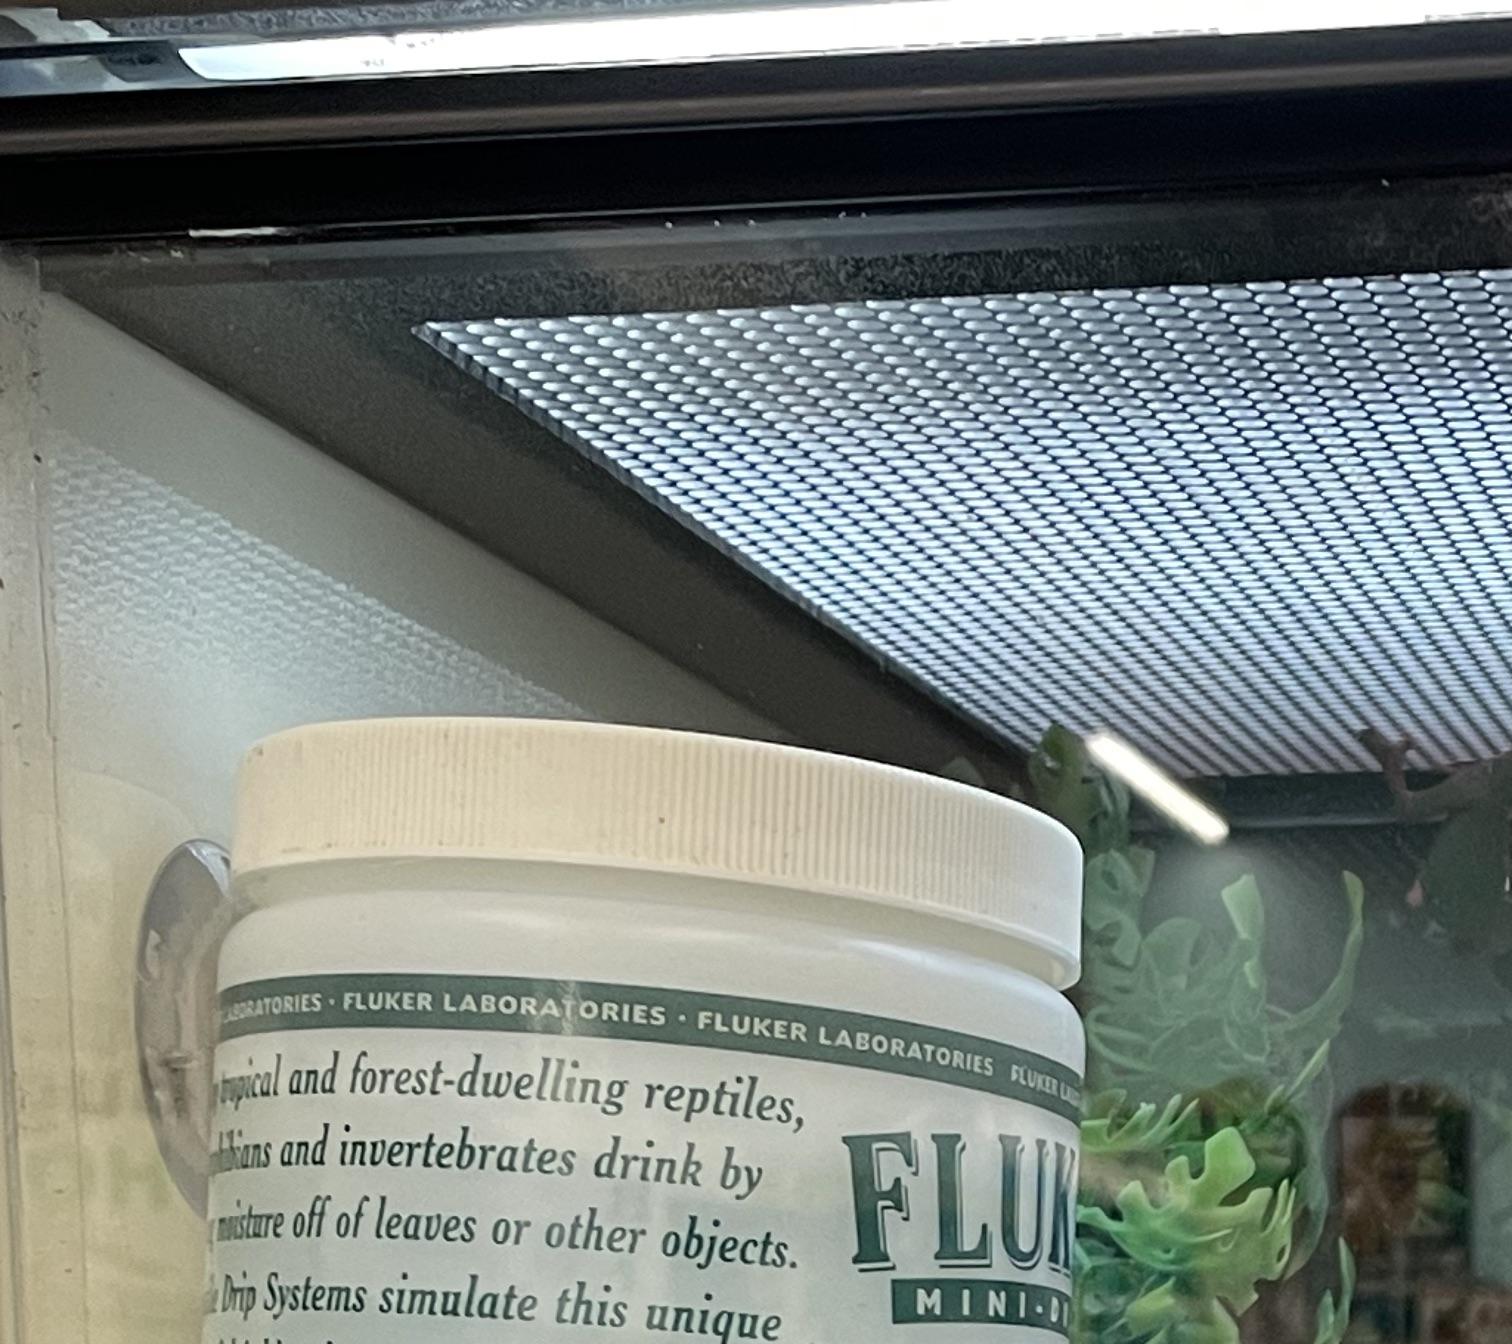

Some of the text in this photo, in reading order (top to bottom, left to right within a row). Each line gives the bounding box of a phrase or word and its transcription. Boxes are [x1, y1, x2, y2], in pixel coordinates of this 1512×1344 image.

[343, 991, 433, 1011] FLUKER
[443, 993, 667, 1026] LABORATORIES
[697, 1011, 808, 1042] FLUKER
[818, 1026, 994, 1076] LABORATORIES
[1011, 1064, 1058, 1096] FLUKER
[288, 1050, 340, 1095] and
[350, 1050, 629, 1116] forest-dwelling
[645, 1075, 804, 1133] reptiles,
[280, 1122, 330, 1167] and
[340, 1124, 577, 1177] invertebrates
[594, 1135, 703, 1187] drink
[720, 1146, 763, 1200] by
[293, 1194, 332, 1238] off
[336, 1194, 370, 1239] of
[375, 1195, 477, 1244] leaves
[492, 1217, 532, 1246] or
[545, 1206, 647, 1254] other
[662, 1214, 797, 1270] objects.
[221, 1270, 257, 1321] Drip
[263, 1271, 368, 1320] Systems
[378, 1272, 538, 1322] simulate
[555, 1280, 628, 1327] this
